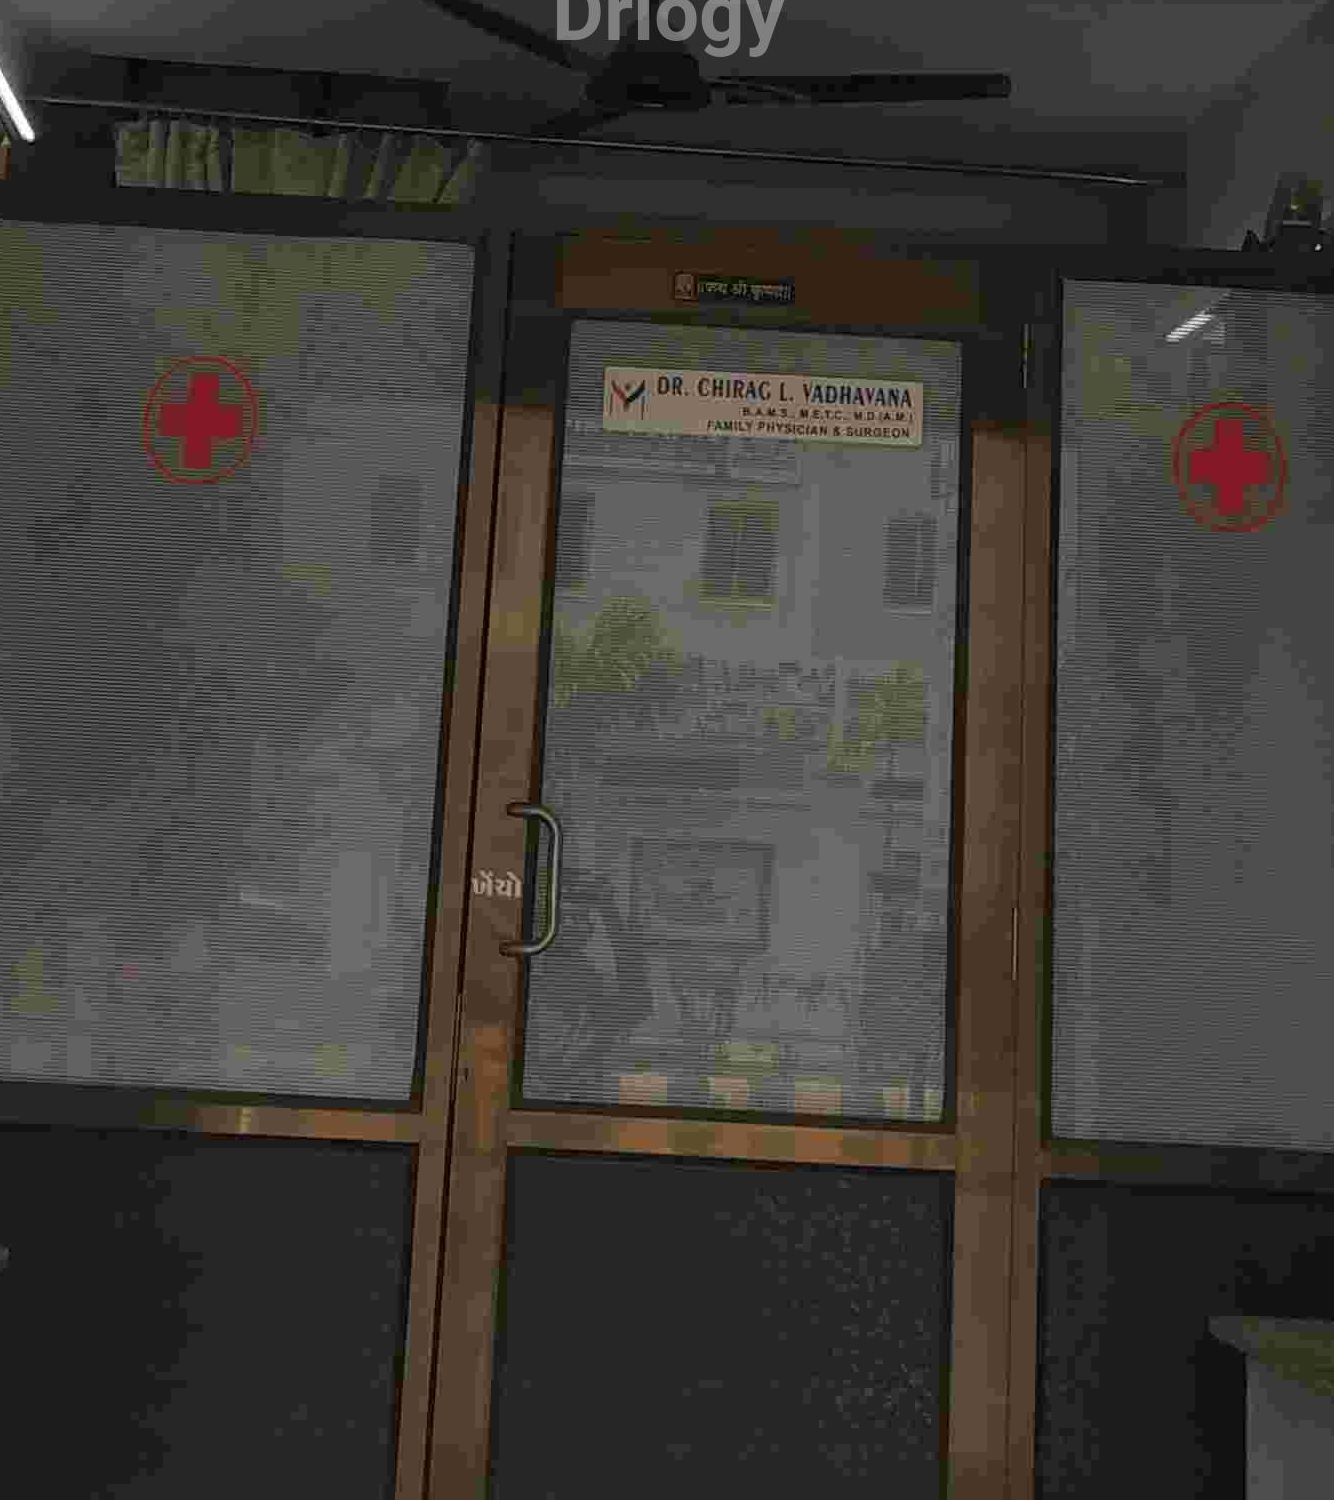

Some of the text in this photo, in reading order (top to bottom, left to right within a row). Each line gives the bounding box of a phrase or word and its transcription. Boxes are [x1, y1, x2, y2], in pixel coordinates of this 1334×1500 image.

[656, 375, 913, 408] DR. CHIRAG L. VADHAVANA
[706, 419, 754, 432] FAMILY
[755, 420, 828, 436] PHYSICIAN
[846, 426, 909, 438] SURGEON
